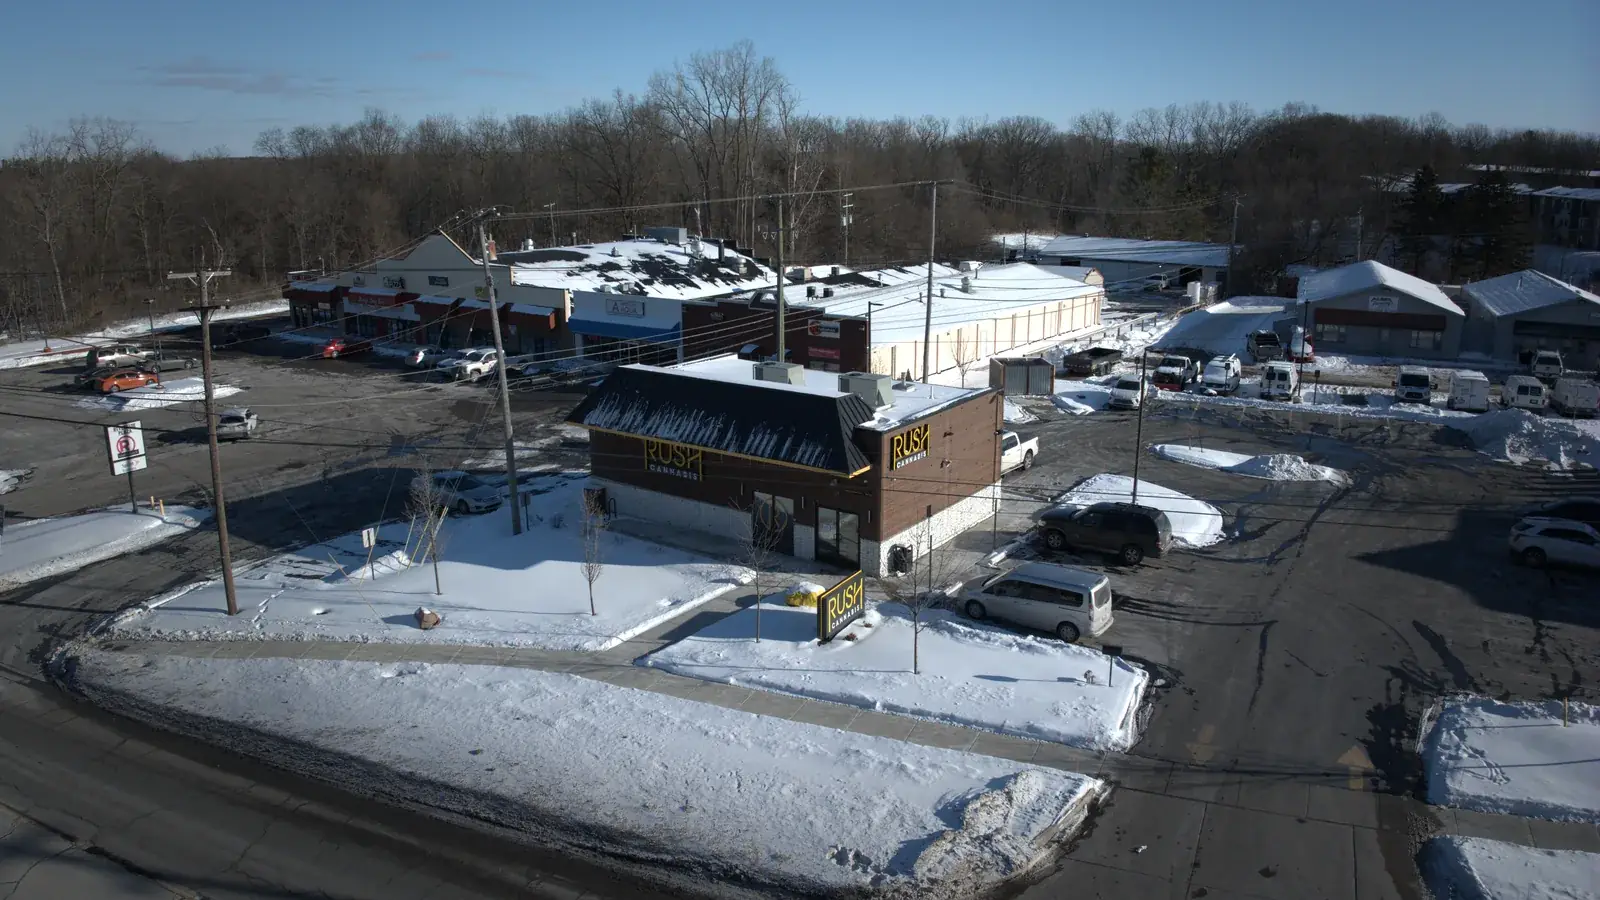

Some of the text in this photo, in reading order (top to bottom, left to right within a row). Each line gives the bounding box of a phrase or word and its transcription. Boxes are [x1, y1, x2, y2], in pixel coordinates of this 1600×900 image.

[644, 440, 702, 481] RUSH
[893, 424, 930, 470] RUSH
[896, 450, 927, 468] CANNABIS
[649, 464, 698, 480] CANNABIS
[828, 578, 863, 632] RUSH
[831, 604, 860, 629] CANNABIS
